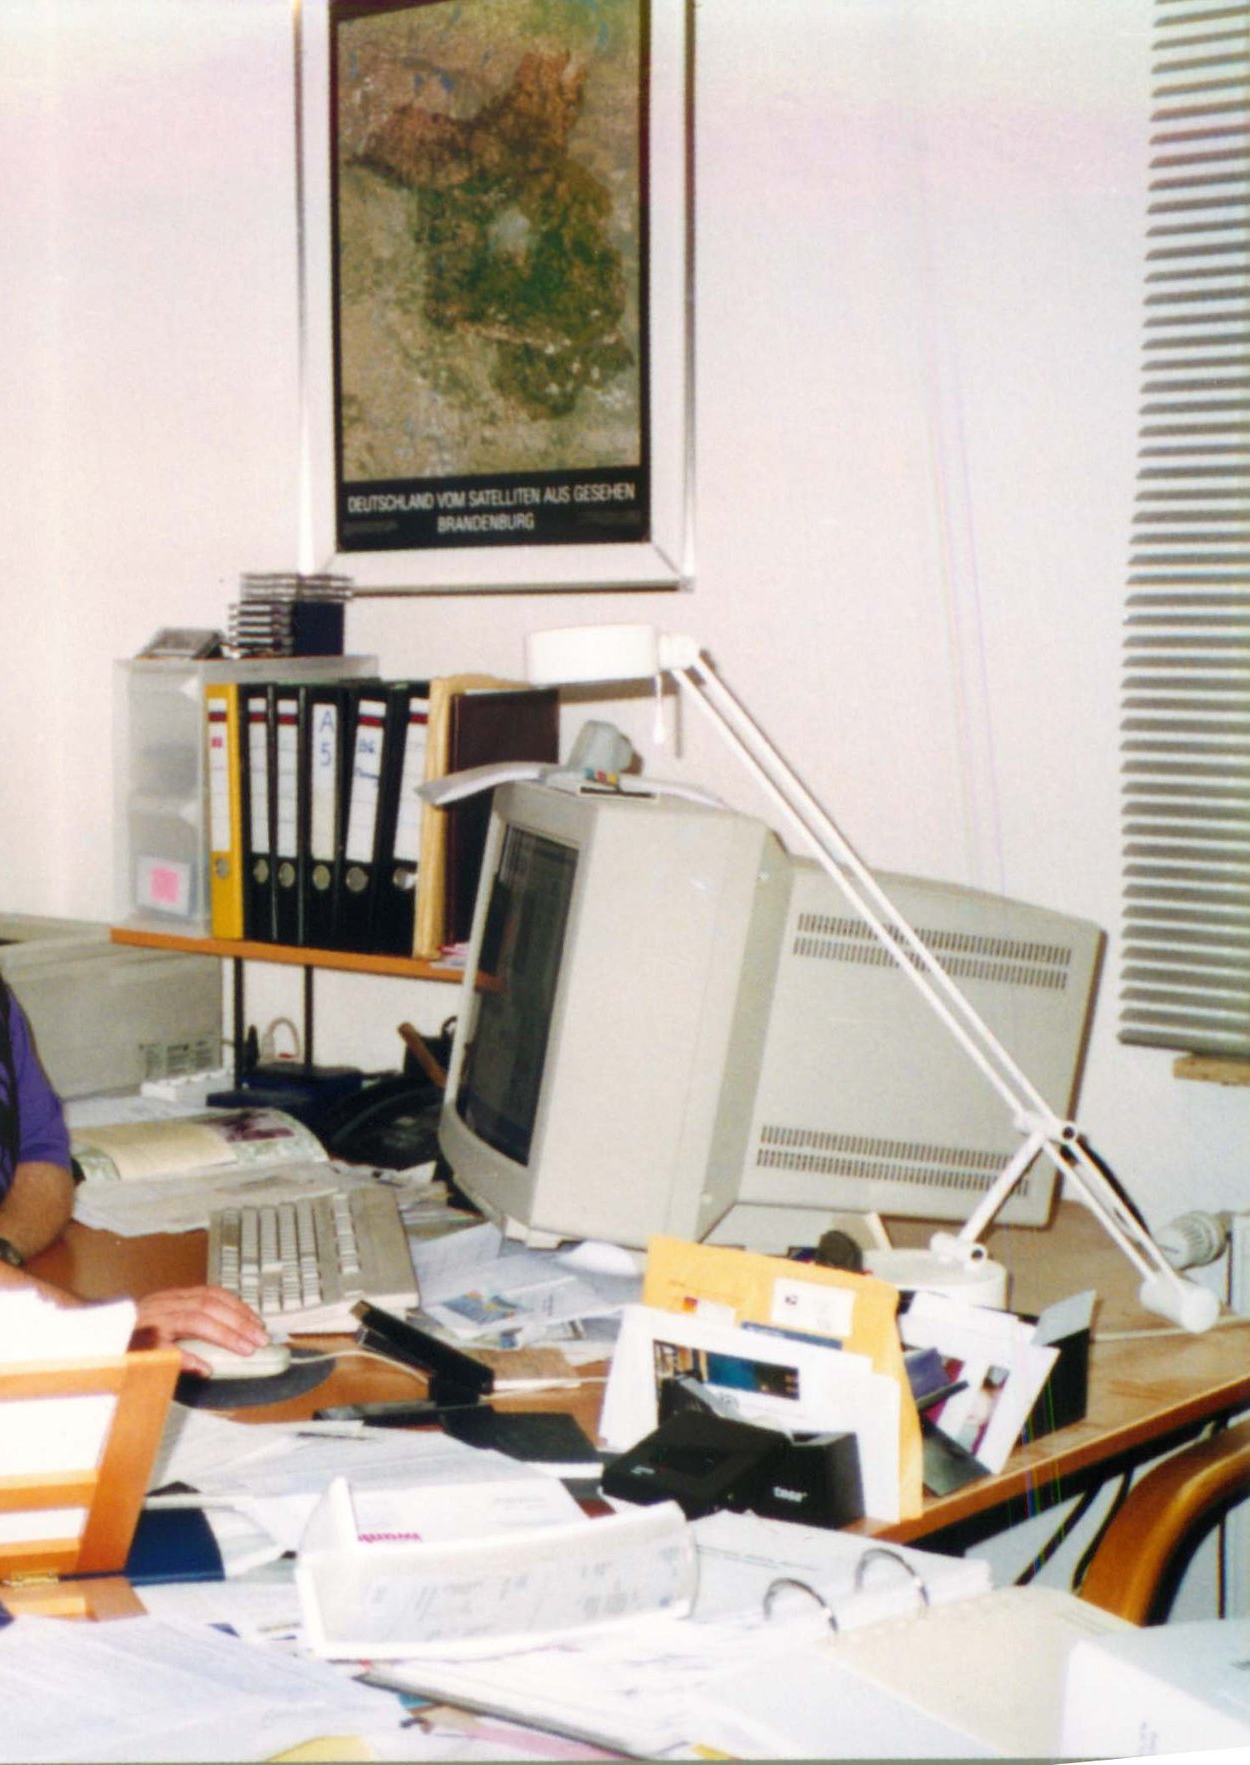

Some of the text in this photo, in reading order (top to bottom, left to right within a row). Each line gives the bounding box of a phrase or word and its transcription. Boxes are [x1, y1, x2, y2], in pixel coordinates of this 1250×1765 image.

[347, 482, 636, 514] DEUTSCHLAND VOM SATELLITEN AUS GESEHEN
[436, 512, 535, 534] BRANDENBURG
[319, 710, 334, 733] A
[320, 742, 332, 767] 5
